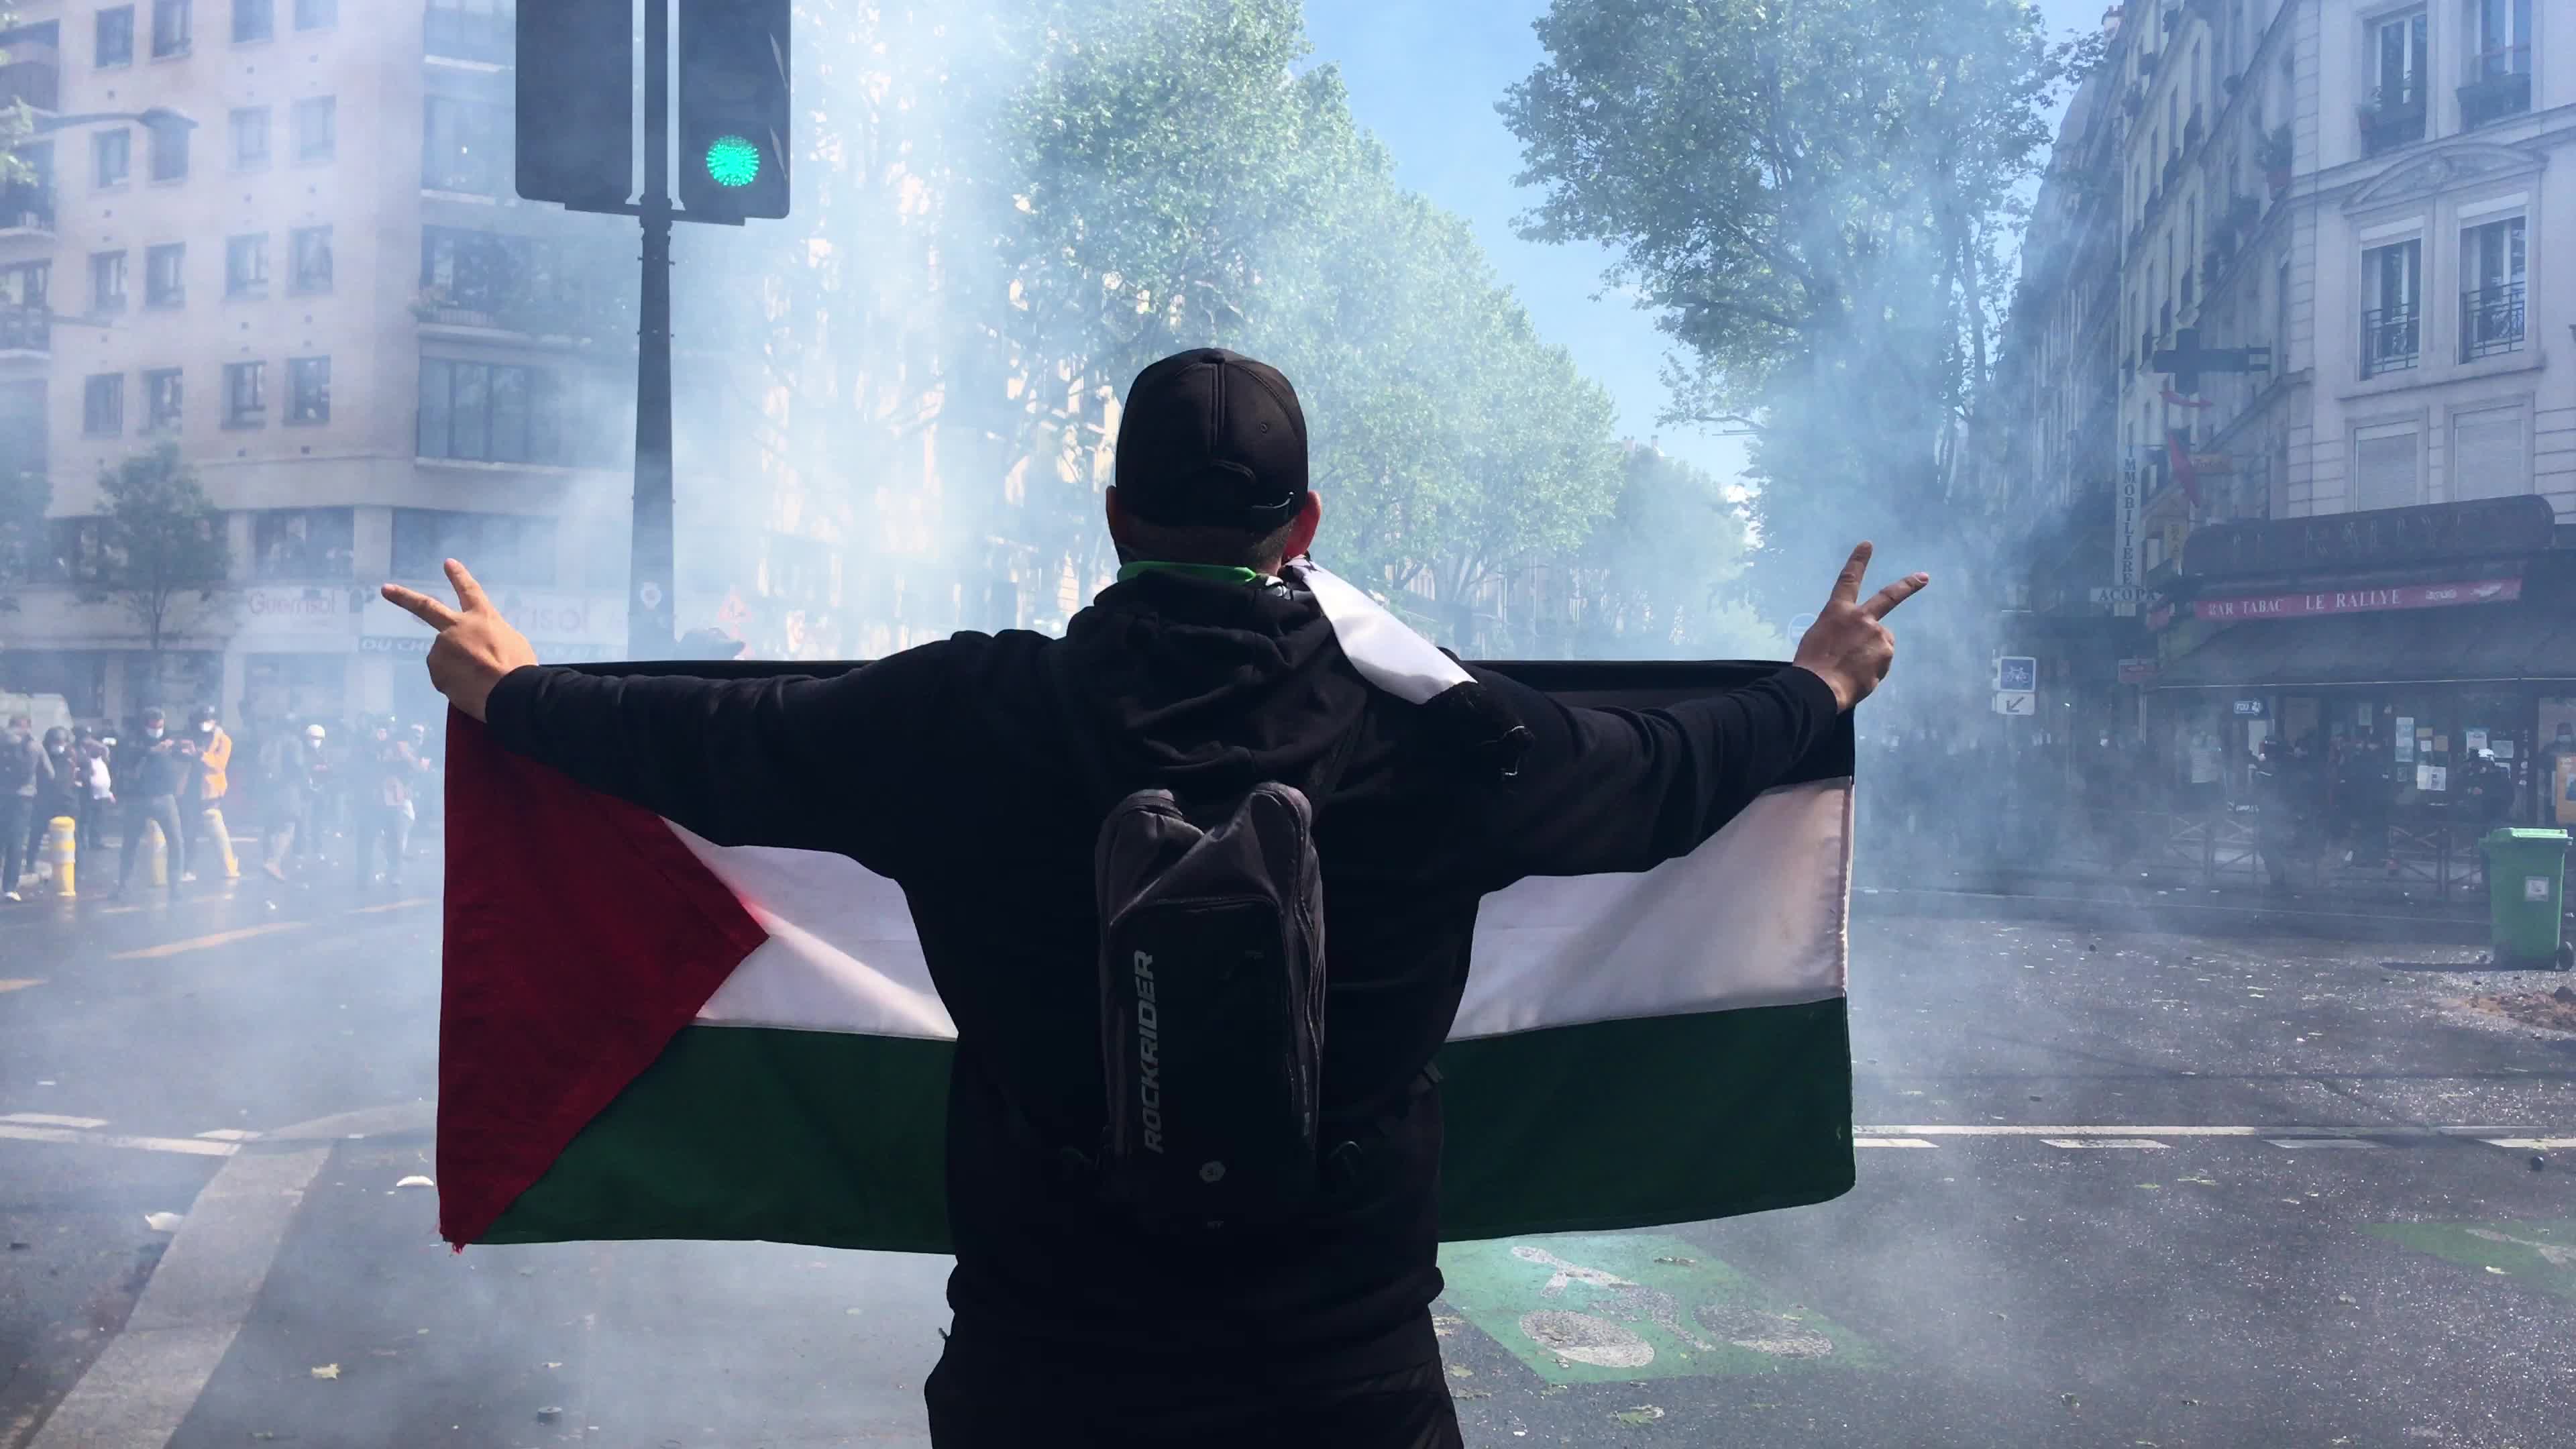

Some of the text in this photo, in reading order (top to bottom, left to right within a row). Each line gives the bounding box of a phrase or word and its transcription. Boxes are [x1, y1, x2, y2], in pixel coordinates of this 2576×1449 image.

[2122, 444, 2137, 584] IMMOBILIERE
[2208, 589, 2400, 616] BAR TABAC LE RALLYE
[1133, 949, 1164, 1155] ROCKRIDER
